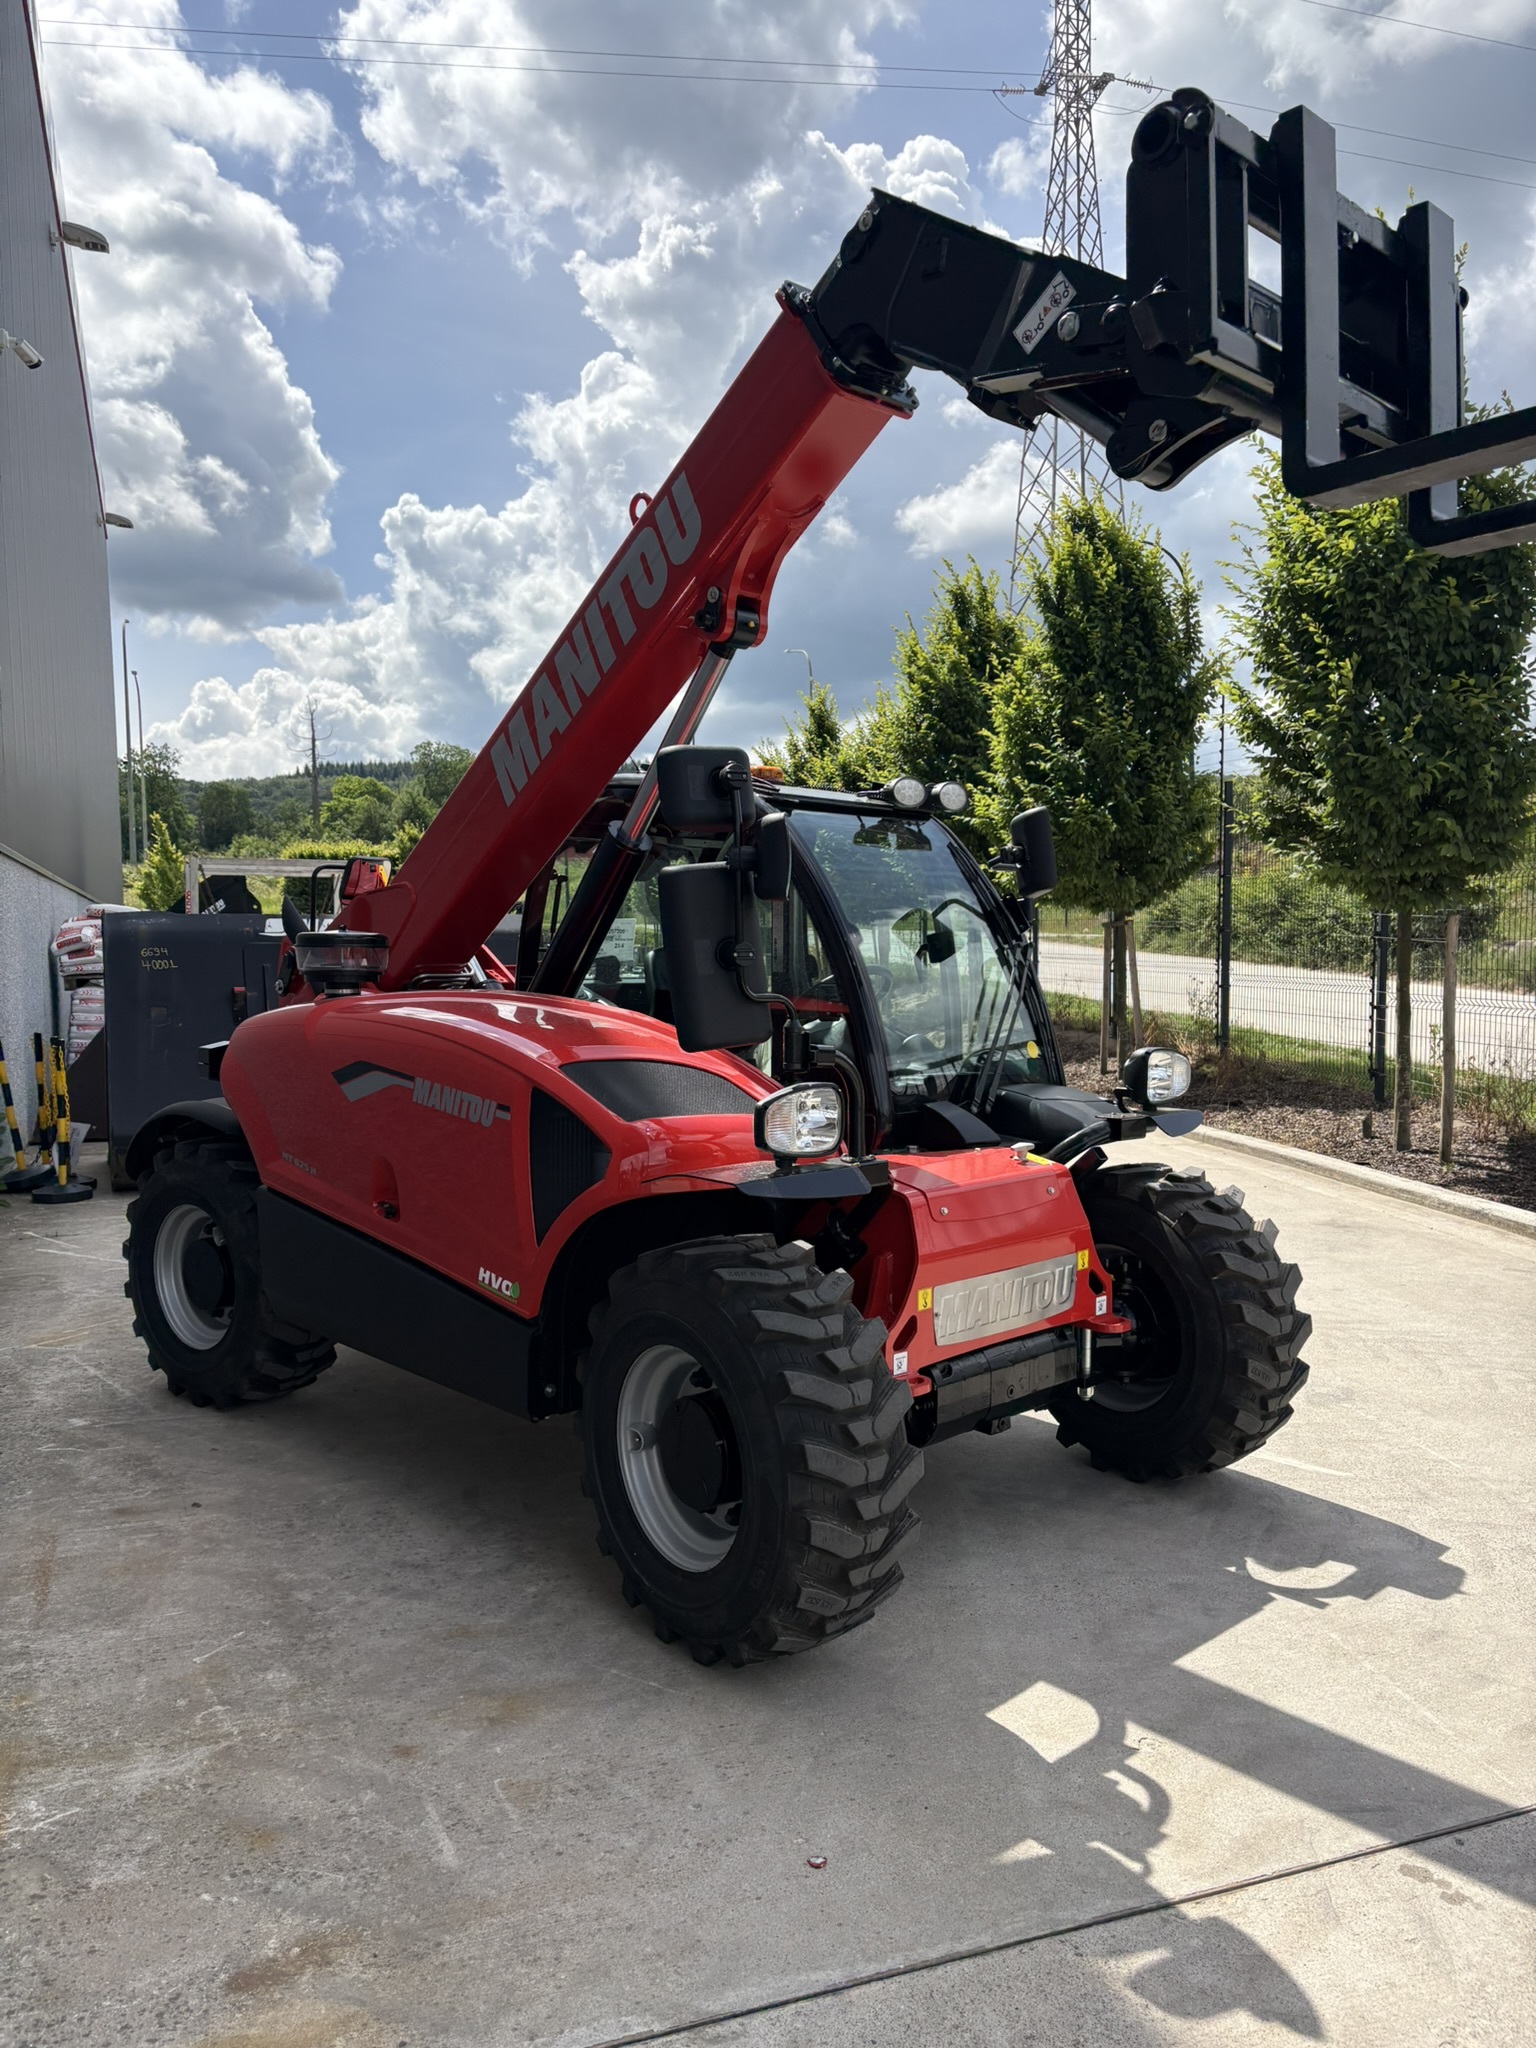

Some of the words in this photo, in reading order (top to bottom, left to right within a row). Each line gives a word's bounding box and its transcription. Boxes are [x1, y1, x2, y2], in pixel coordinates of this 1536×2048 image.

[490, 470, 702, 807] MANITOU
[412, 1077, 497, 1128] MANITOU
[939, 1264, 1074, 1338] MANITOU
